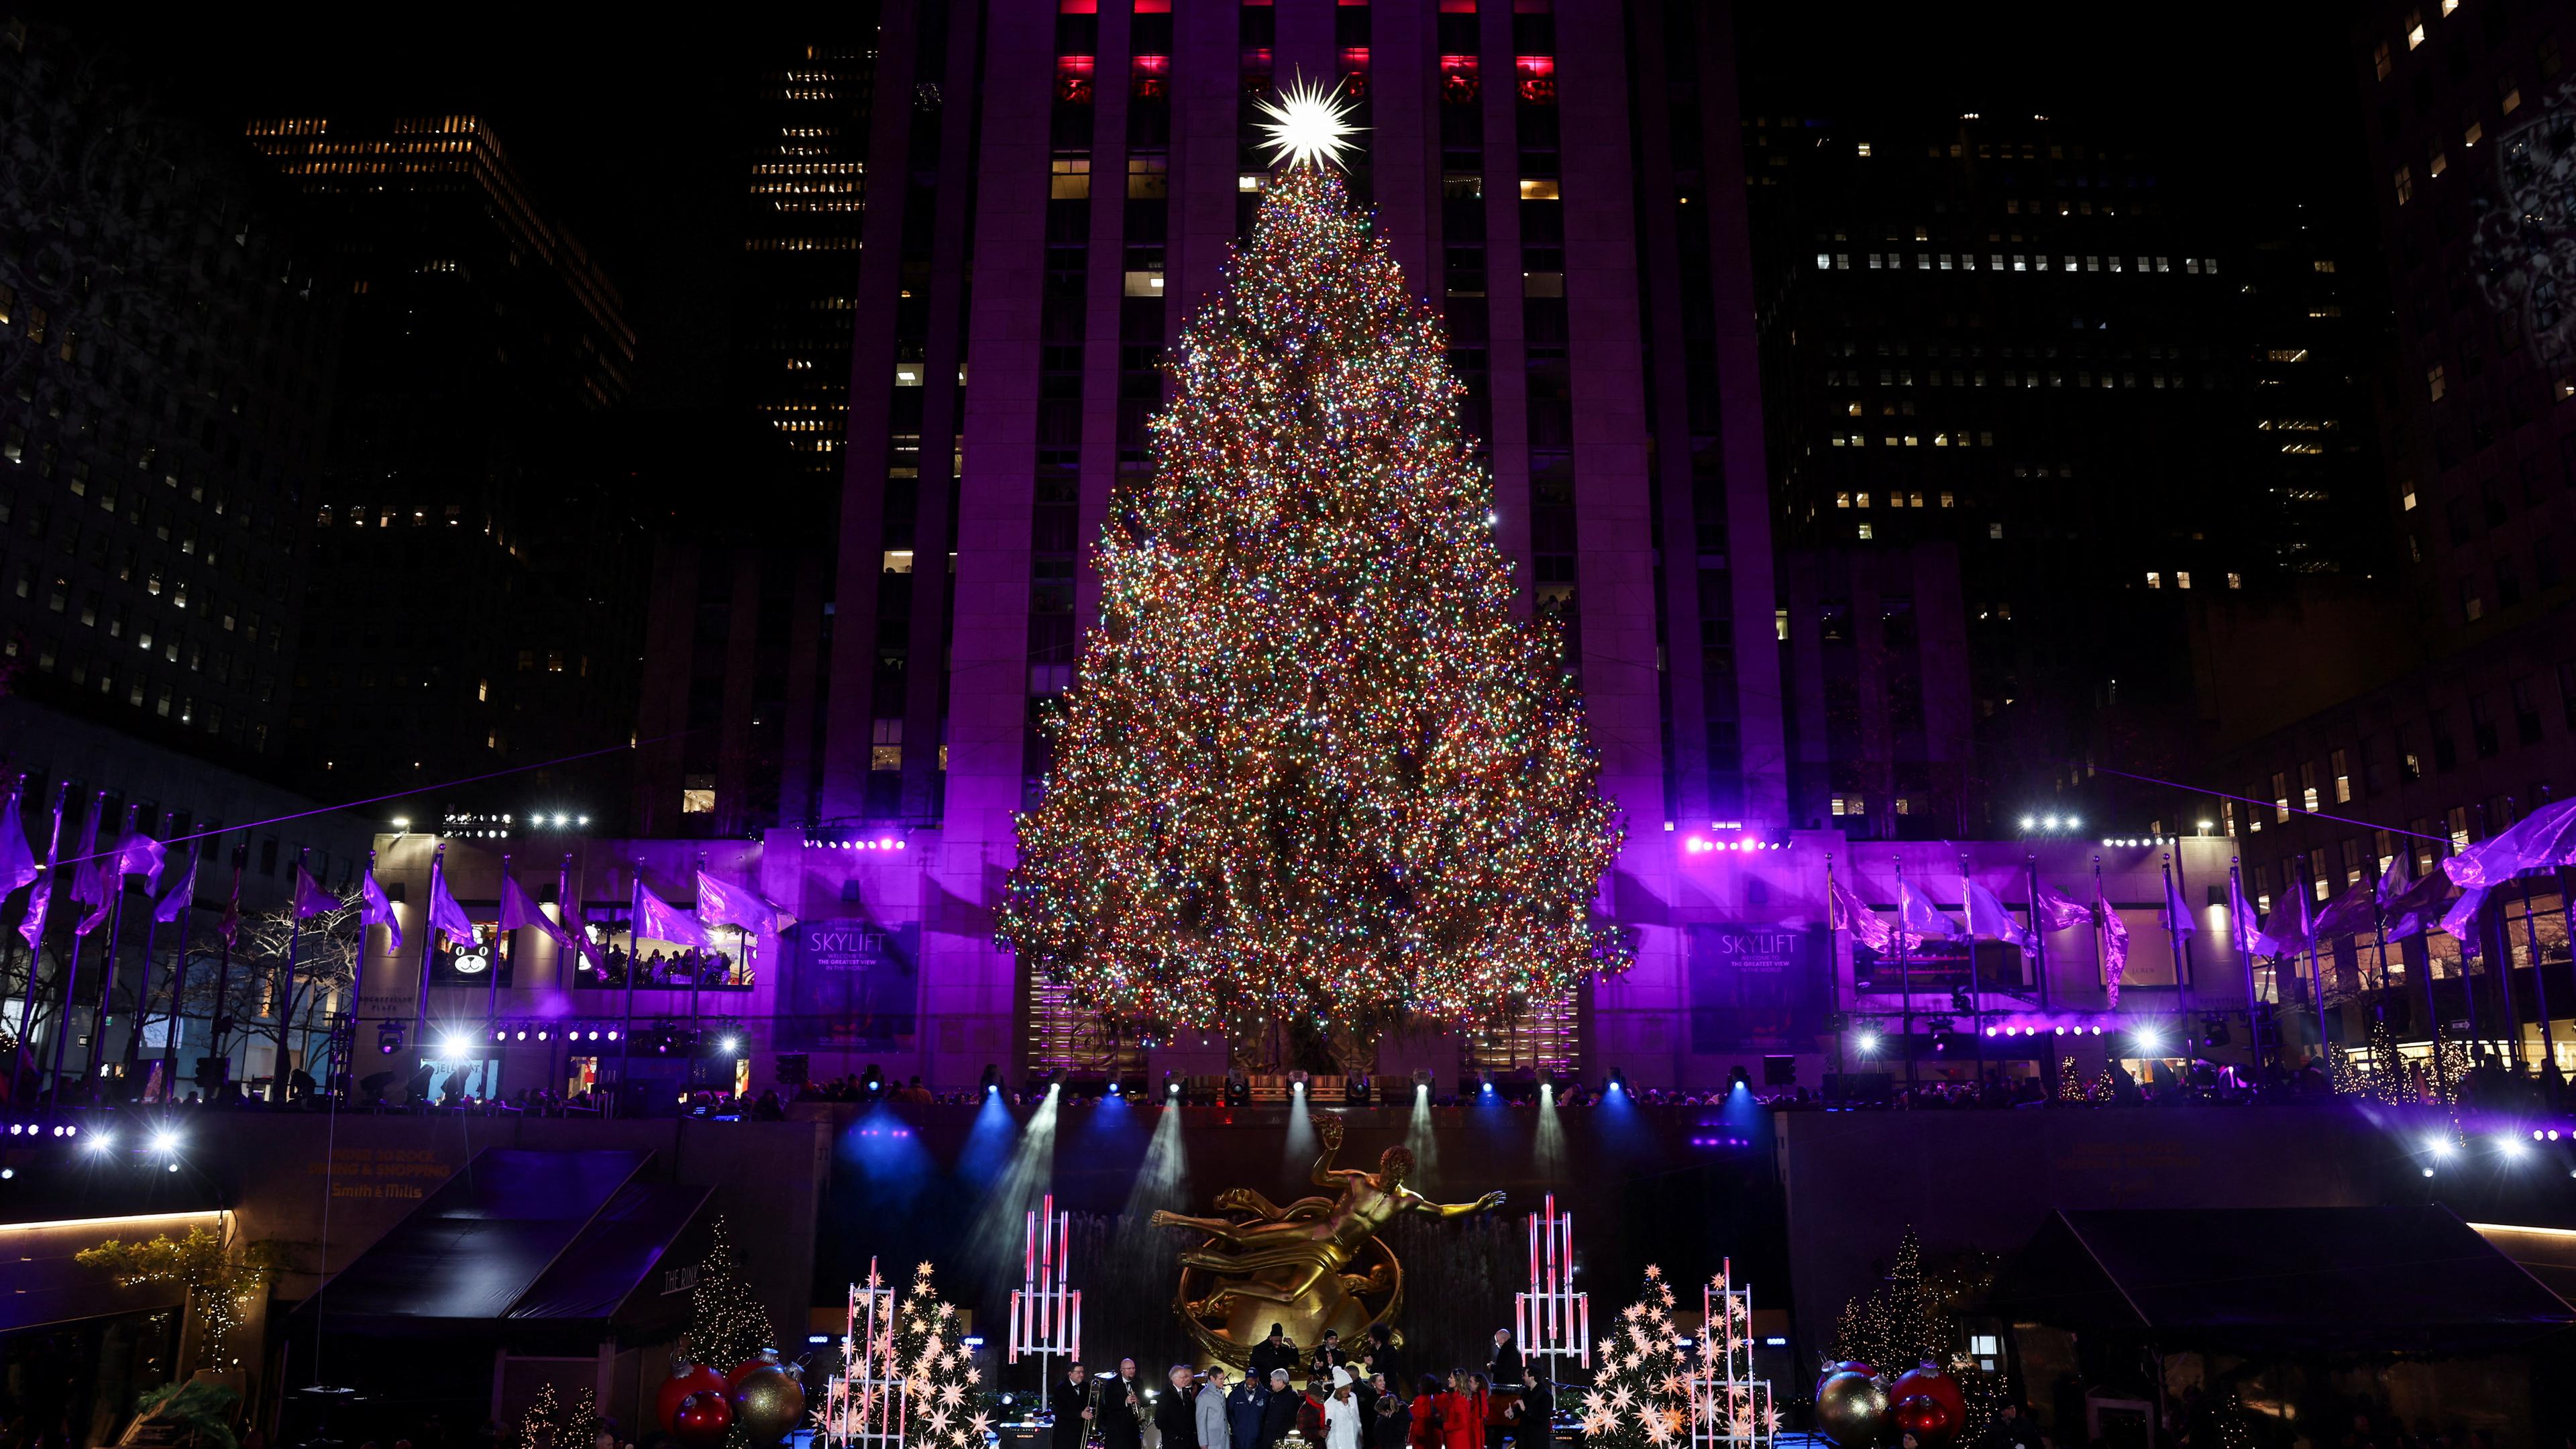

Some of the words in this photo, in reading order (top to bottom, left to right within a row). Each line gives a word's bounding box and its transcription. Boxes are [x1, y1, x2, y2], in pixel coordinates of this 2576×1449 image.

[810, 933, 885, 951] SKYLIFT
[1723, 935, 1796, 953] SKYLIFT
[376, 1164, 451, 1177] SHOPPING
[332, 1183, 372, 1197] Smith
[386, 1183, 423, 1198] Mills
[665, 1269, 679, 1292] THE
[681, 1263, 700, 1288] RINK
